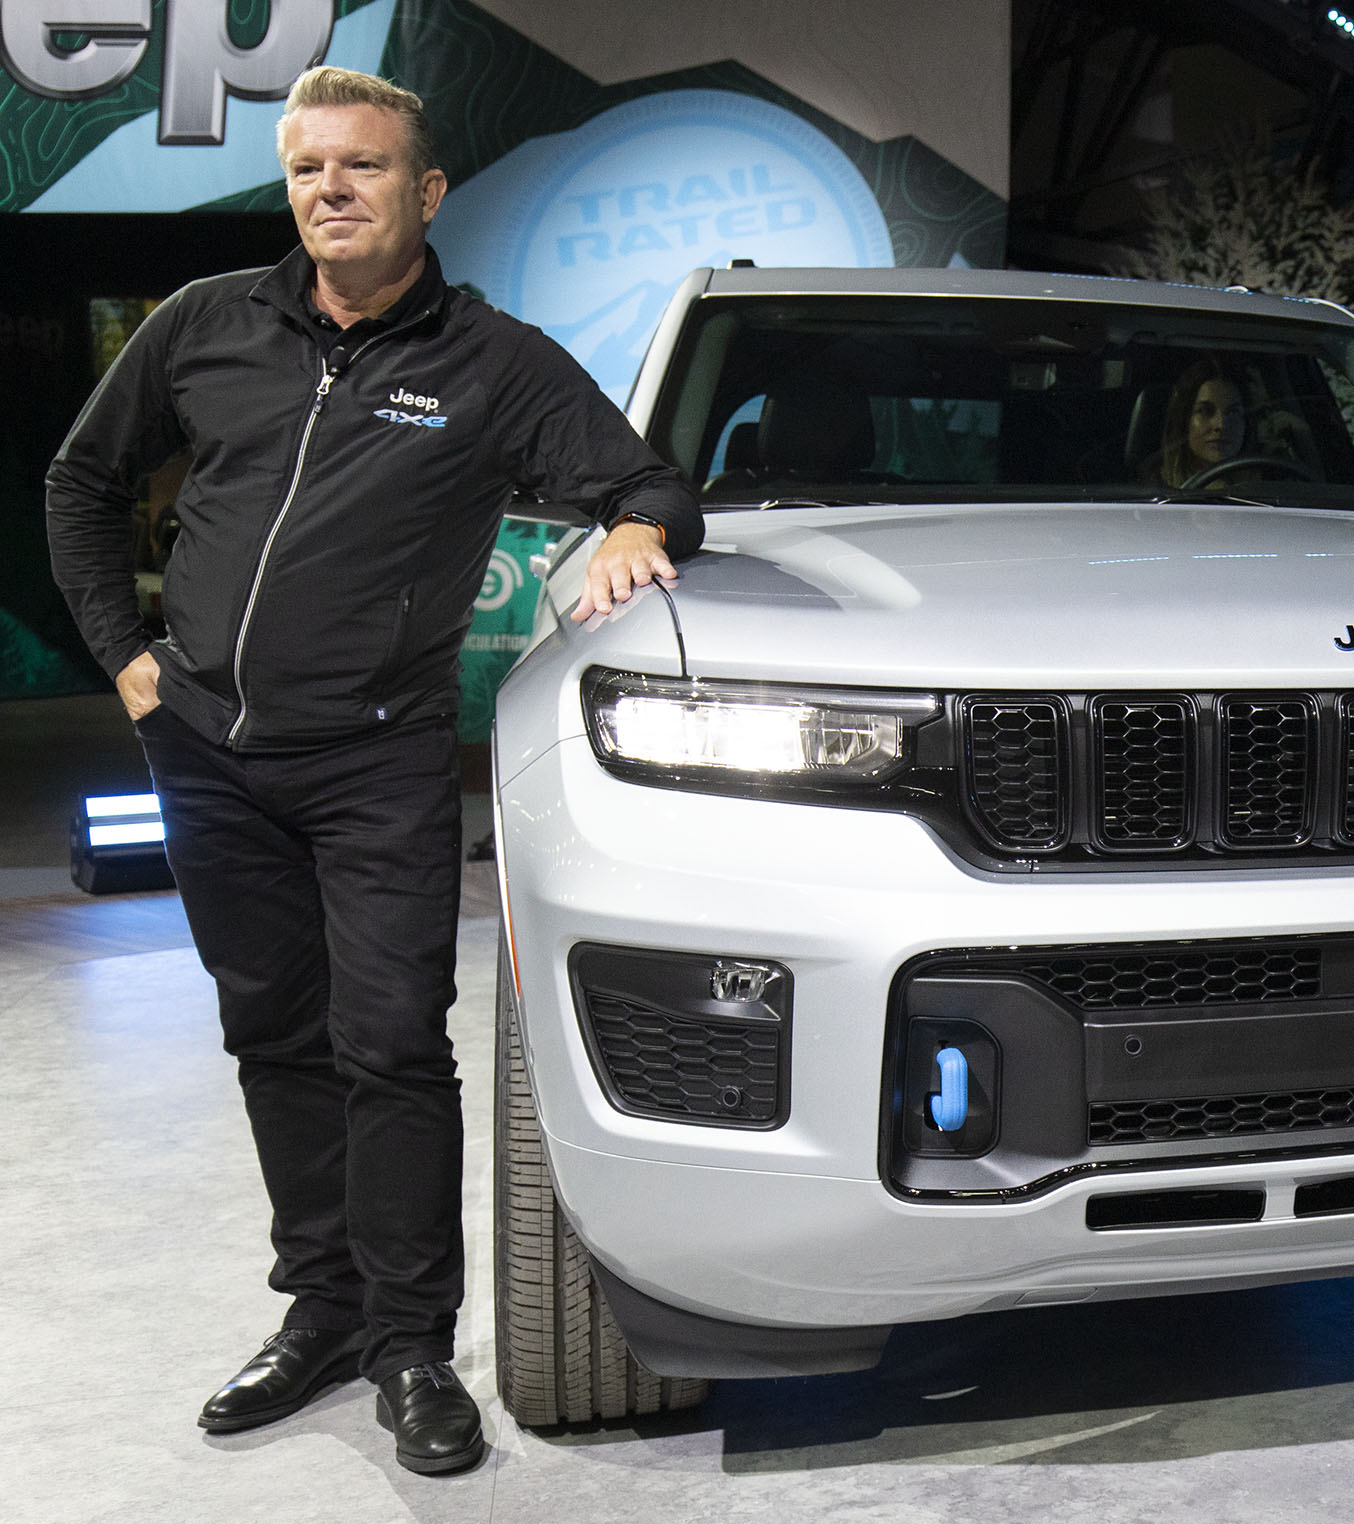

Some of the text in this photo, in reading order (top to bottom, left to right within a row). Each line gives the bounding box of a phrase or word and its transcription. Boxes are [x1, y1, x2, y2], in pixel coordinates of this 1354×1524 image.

[569, 164, 797, 224] TRAIL
[557, 196, 817, 268] RATED
[389, 387, 440, 412] Jeep
[464, 633, 530, 652] CULATION
